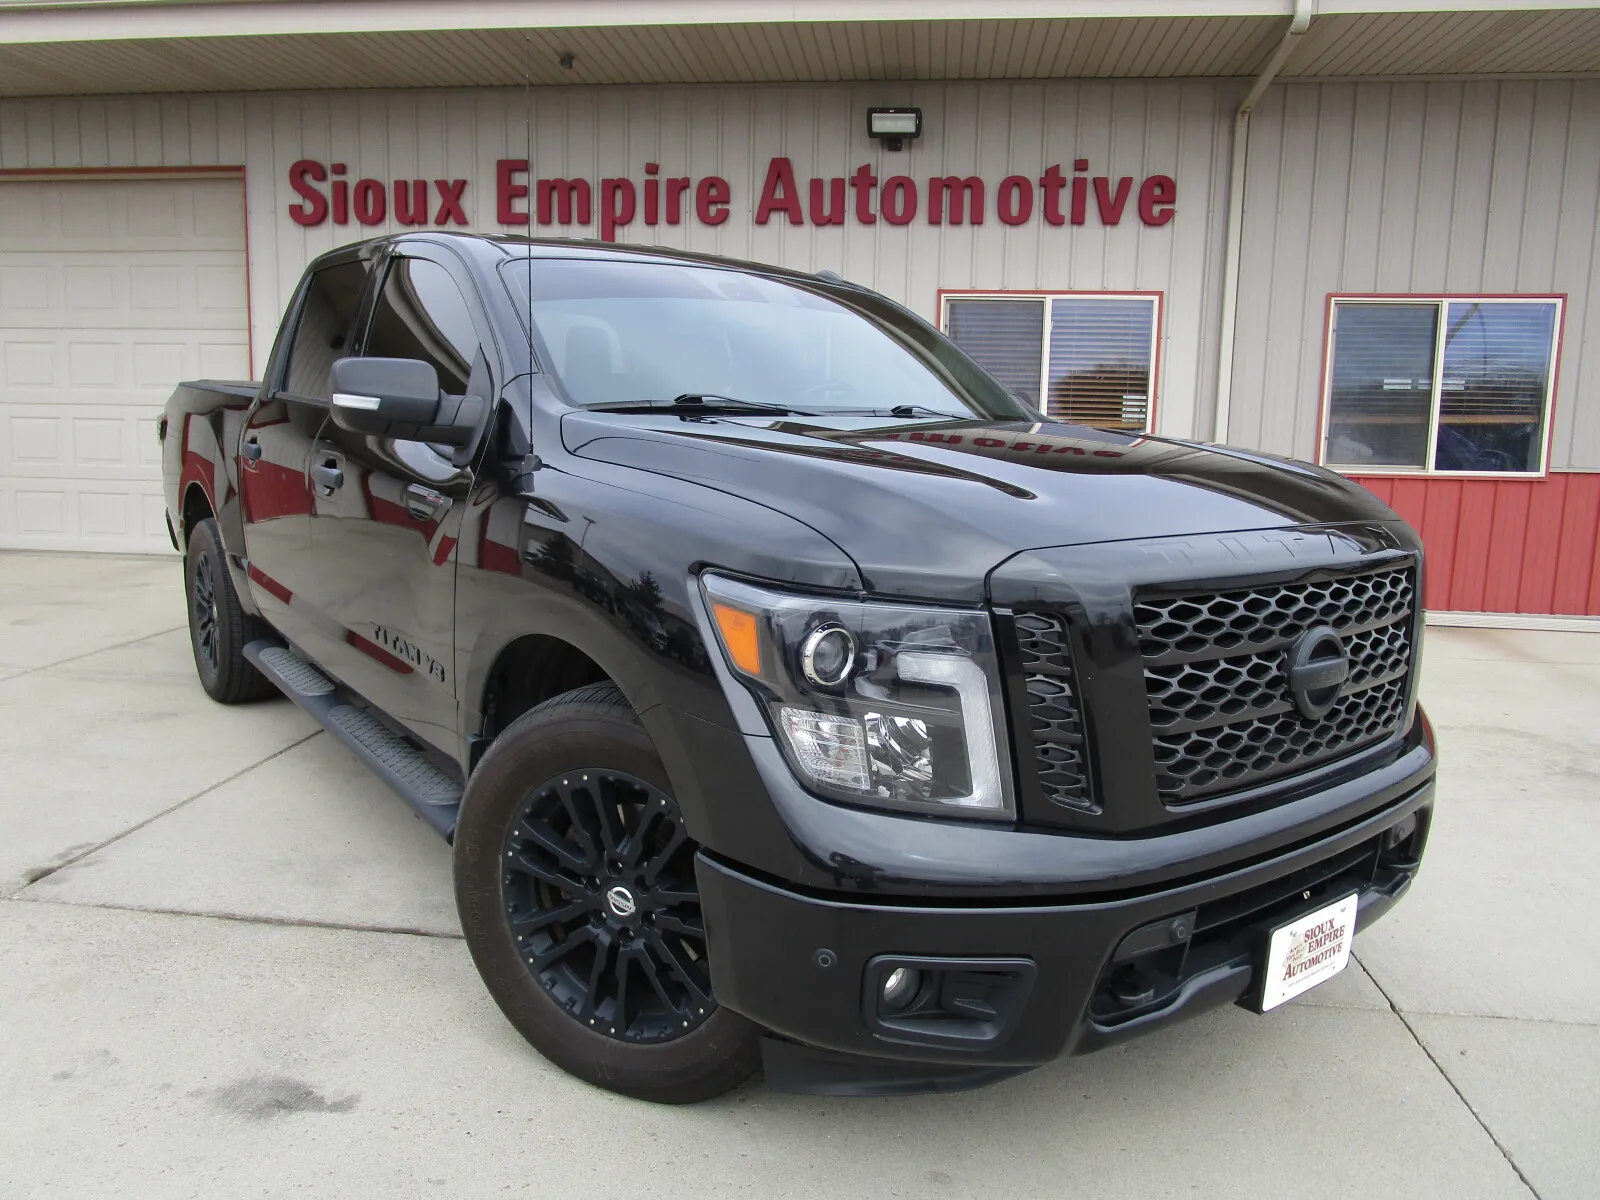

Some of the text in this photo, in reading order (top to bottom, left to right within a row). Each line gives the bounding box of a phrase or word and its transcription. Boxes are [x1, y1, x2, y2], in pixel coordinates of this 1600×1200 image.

[288, 157, 1177, 242] Sioux Empire Automotive
[1304, 917, 1335, 943] SIOUX
[1307, 924, 1346, 954] EMPIRE
[1282, 941, 1344, 982] AUTOMOTIVE
